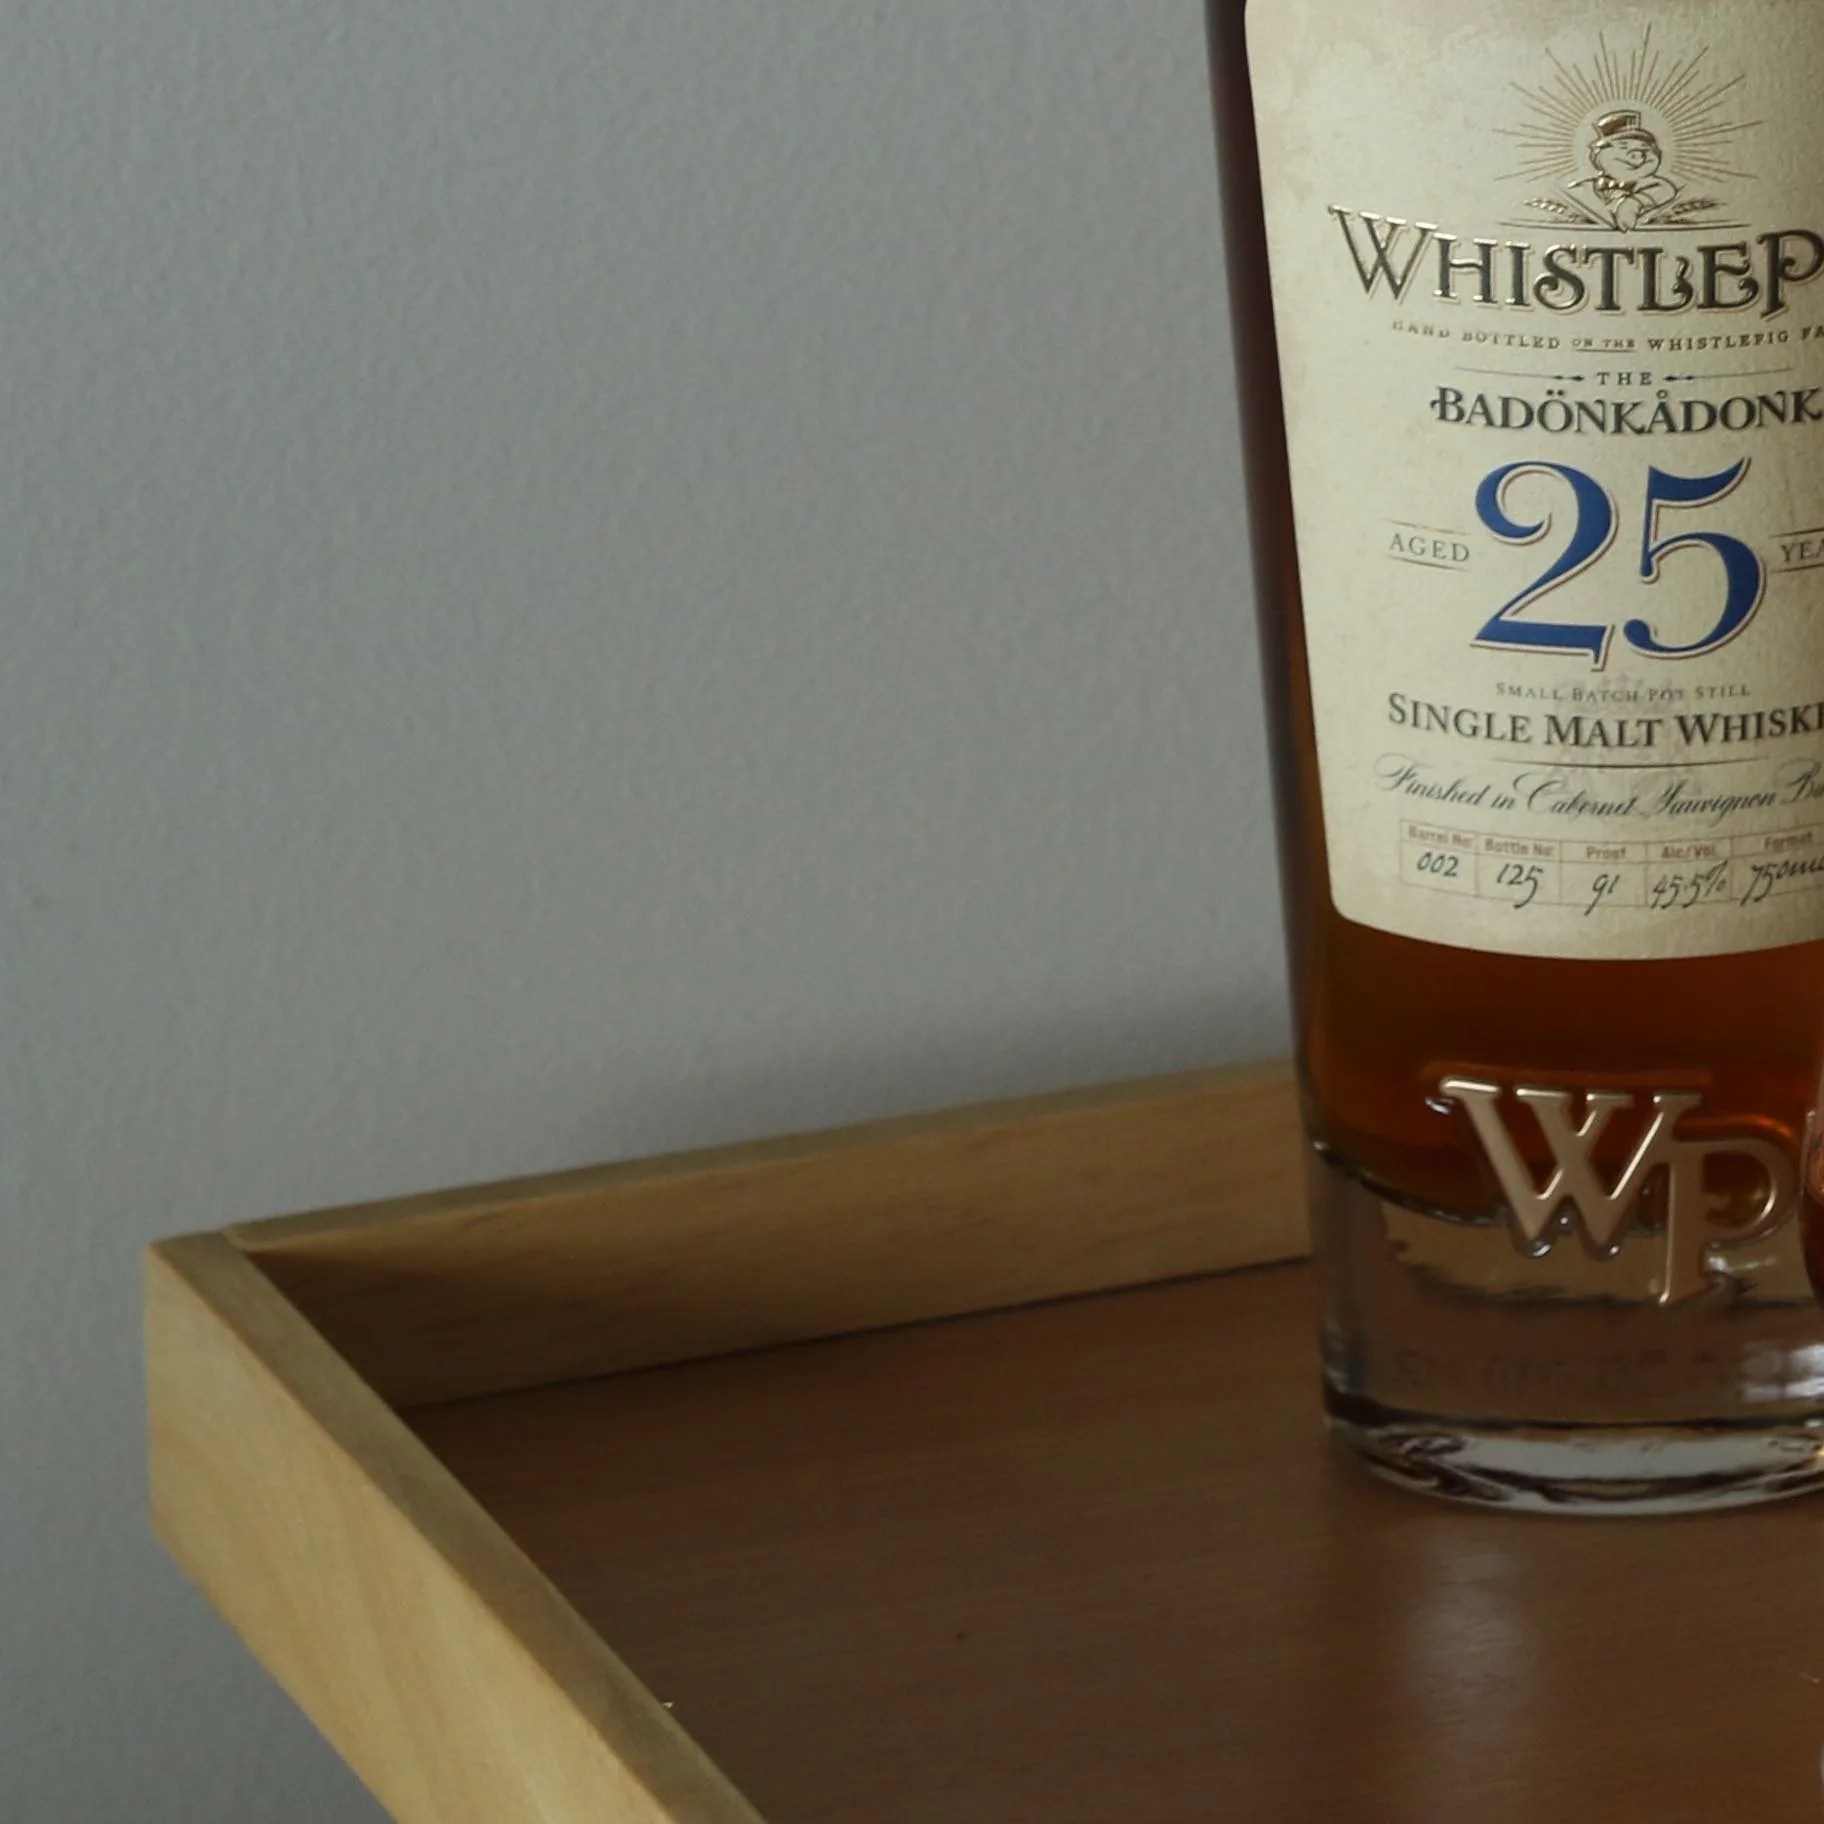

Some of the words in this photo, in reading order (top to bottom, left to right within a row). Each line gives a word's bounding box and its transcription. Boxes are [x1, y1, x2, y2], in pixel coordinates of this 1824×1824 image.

[1392, 319, 1451, 339] HAND
[1462, 330, 1562, 350] BOTTLED
[1603, 338, 1636, 349] THE
[1647, 330, 1789, 352] WHISTLEPIG
[1596, 371, 1652, 386] THE
[1429, 385, 1824, 436] BADÖNKÅDONK
[1389, 532, 1471, 563] AGED
[1469, 457, 1767, 673] 25
[1496, 682, 1561, 701] SMALL
[1572, 687, 1638, 704] BATCH
[1648, 687, 1684, 702] POT
[1695, 684, 1752, 700] STILL
[1388, 692, 1533, 744] SINGLE
[1543, 713, 1663, 748] MALT
[1374, 752, 1491, 808] Finished
[1491, 791, 1517, 810] in
[1511, 771, 1638, 823] Cabernet
[1640, 776, 1777, 829] Sauvignon
[1416, 851, 1460, 877] 002
[1484, 837, 1528, 855] Bottle
[1586, 845, 1627, 860] Proof
[1496, 862, 1545, 910] 125
[1583, 873, 1621, 917] 91
[1436, 1074, 1799, 1308] WP
